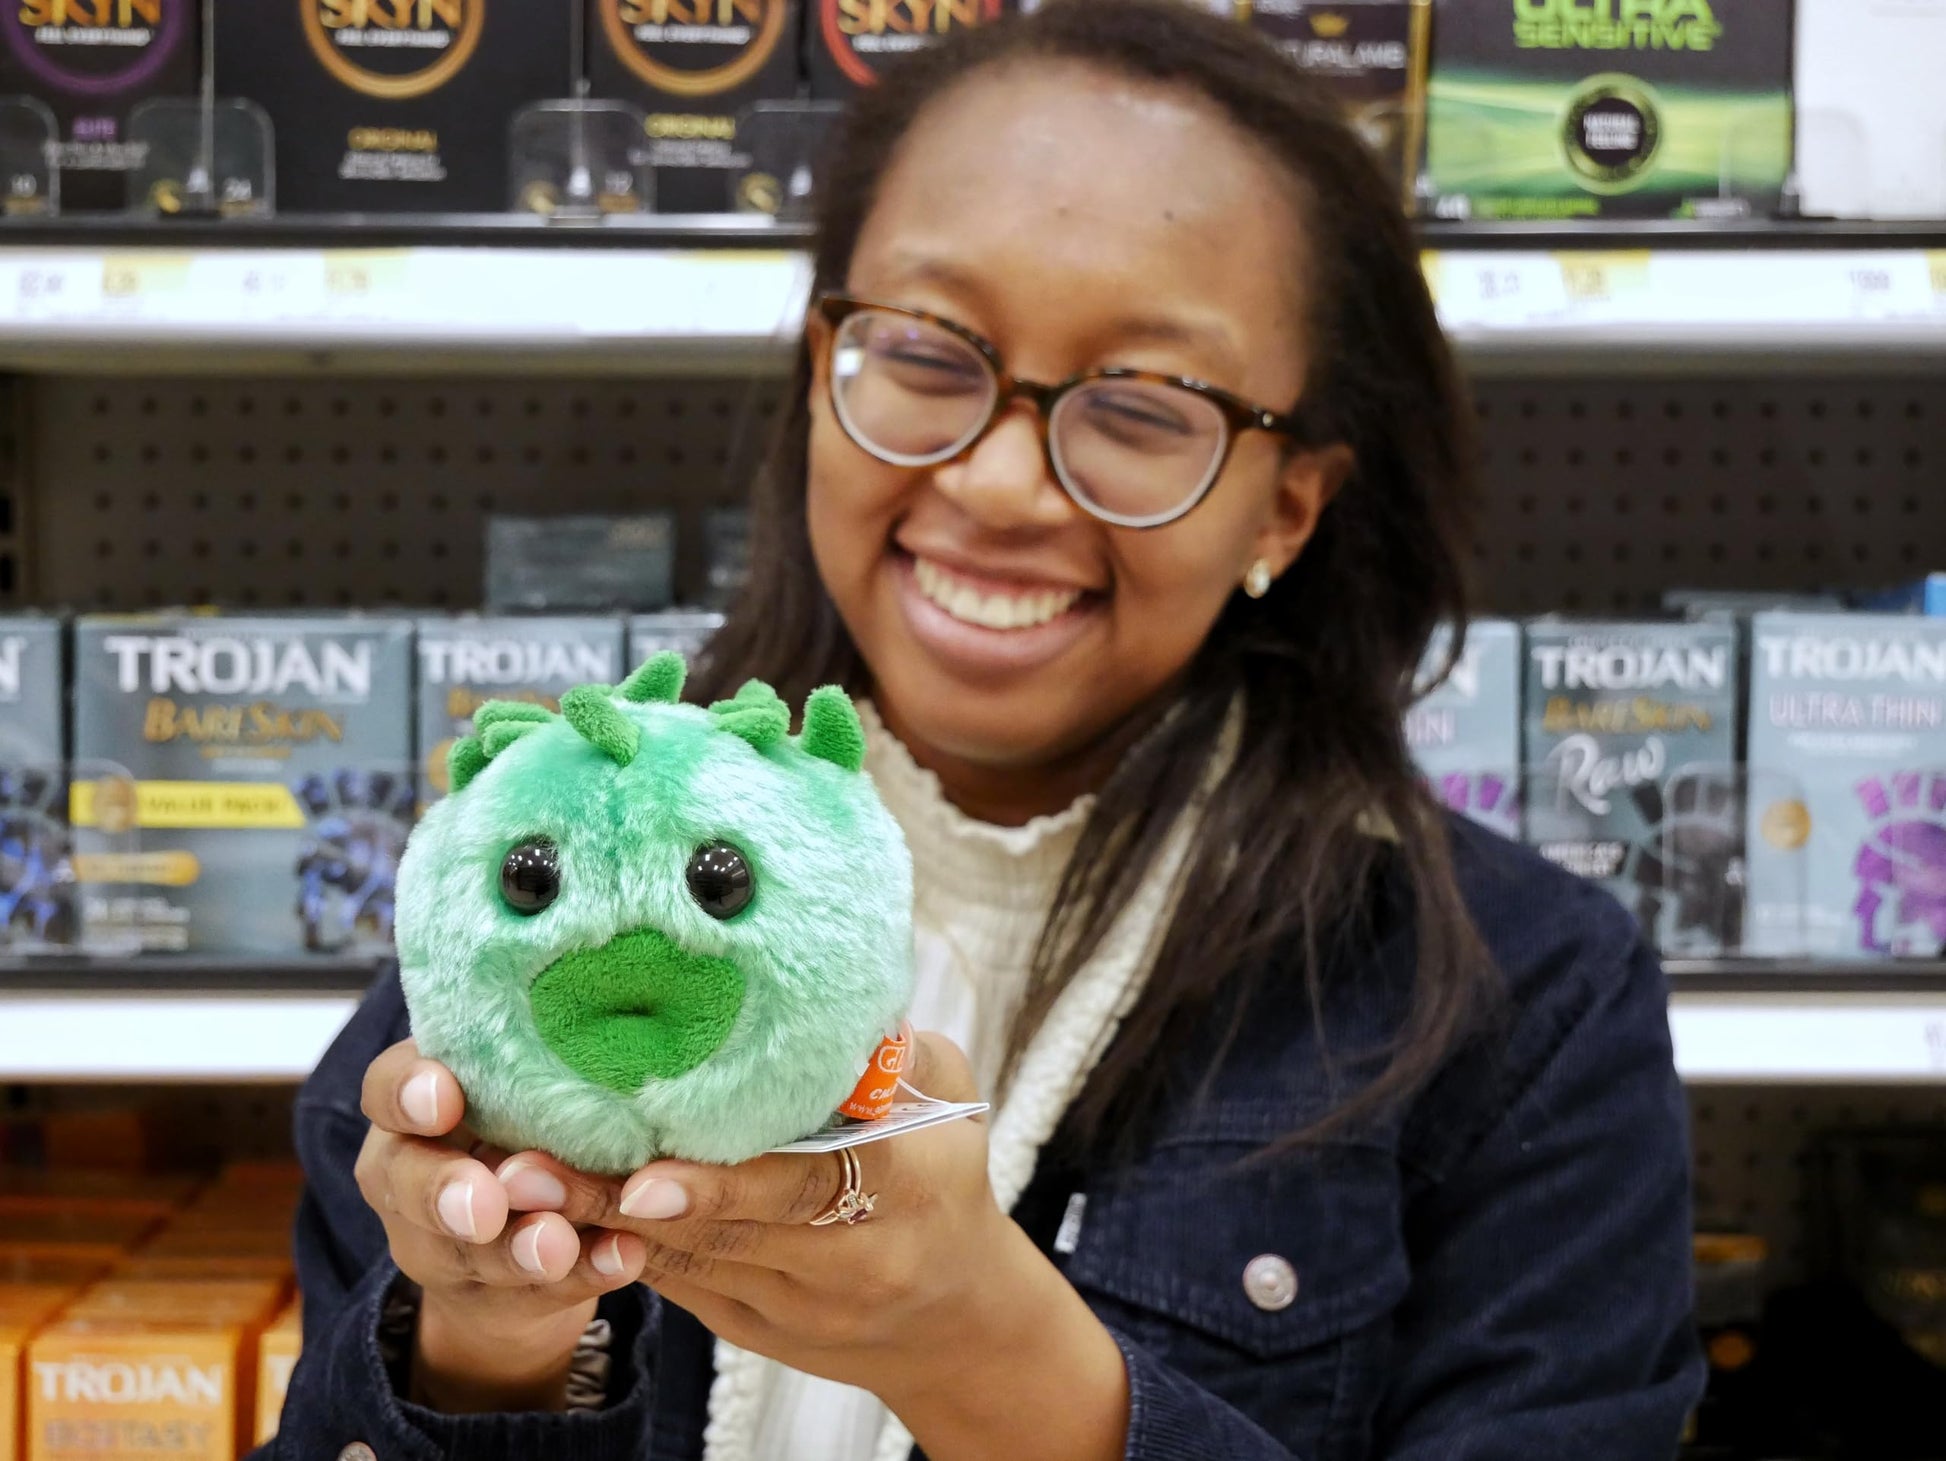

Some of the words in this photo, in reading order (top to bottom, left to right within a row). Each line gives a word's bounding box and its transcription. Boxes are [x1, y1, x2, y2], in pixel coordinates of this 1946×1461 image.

[1512, 20, 1724, 50] SENSITIVE
[104, 635, 373, 696] TROJAN
[419, 639, 612, 684] TROJAN
[1530, 645, 1727, 690] TROJAN
[1757, 634, 1946, 684] TROJAN
[1769, 694, 1861, 728] ULTRA
[1870, 695, 1942, 728] THIN
[32, 1361, 223, 1408] TROJAN
